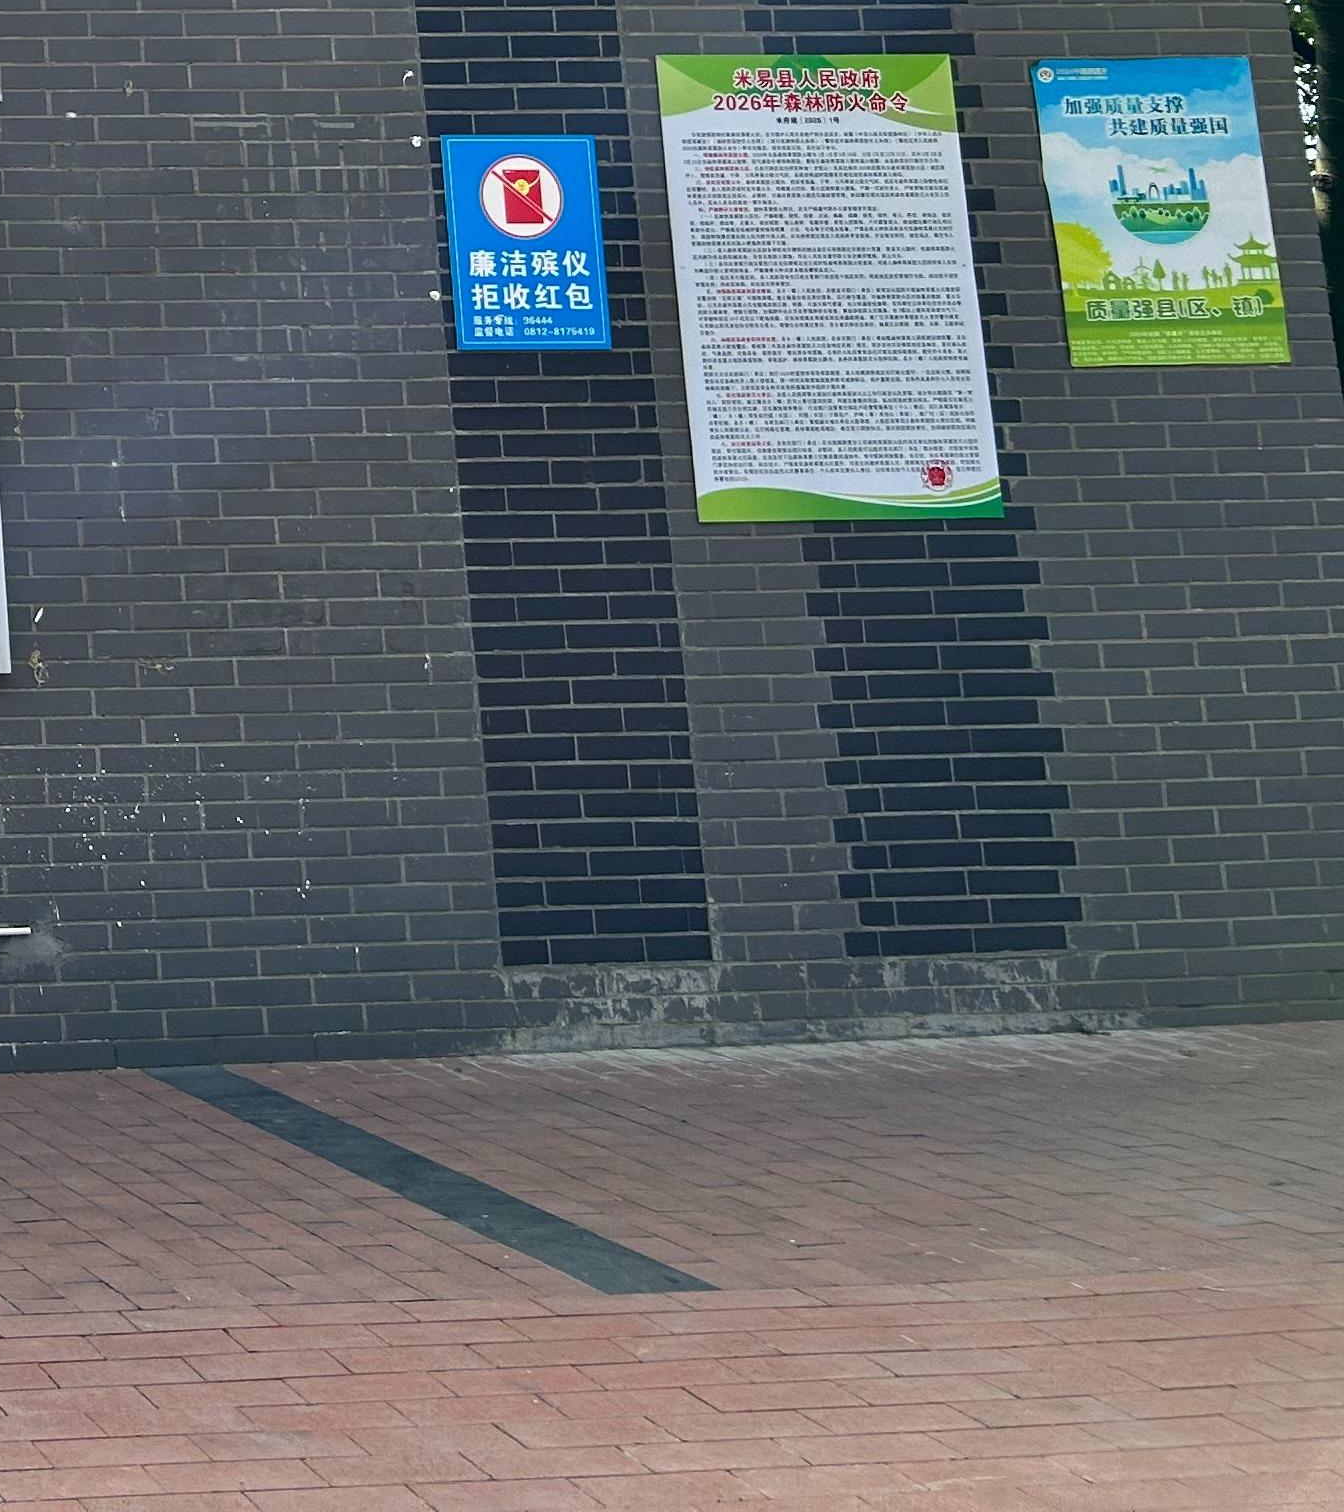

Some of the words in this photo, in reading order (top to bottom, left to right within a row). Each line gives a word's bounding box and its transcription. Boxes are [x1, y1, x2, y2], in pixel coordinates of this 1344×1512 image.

[734, 68, 880, 89] 米易县人民政府
[712, 92, 909, 113] 2026年森林防火命令
[1064, 96, 1185, 115] 加强质量支撑
[1108, 116, 1229, 136] 共建质量强国
[469, 249, 591, 277] 廉洁殡仪
[471, 282, 593, 310] 拒收红包
